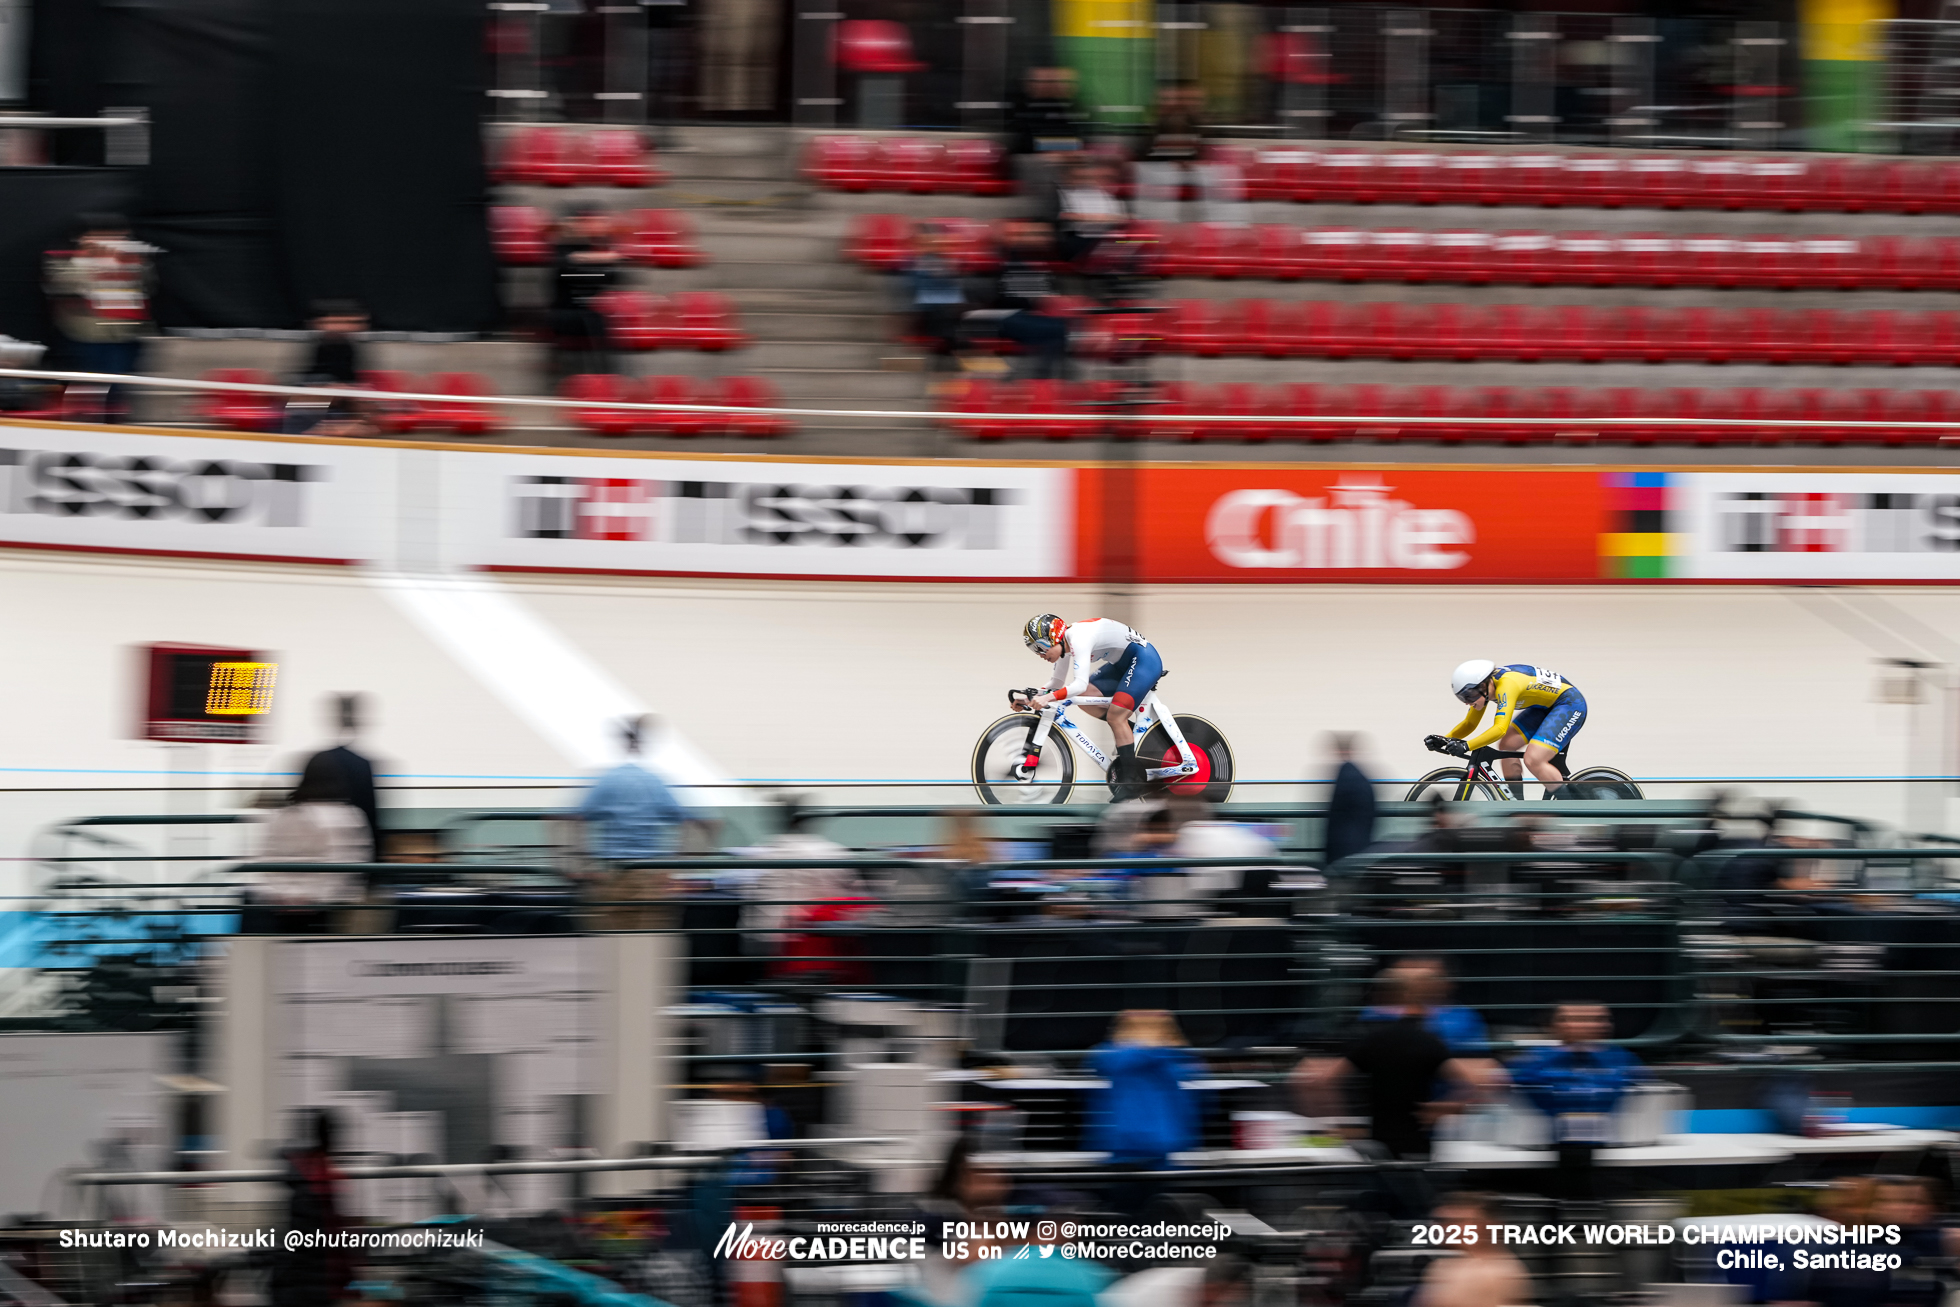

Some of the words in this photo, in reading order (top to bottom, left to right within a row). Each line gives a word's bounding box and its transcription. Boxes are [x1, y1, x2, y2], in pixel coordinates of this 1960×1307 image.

[1204, 488, 1487, 570] Chile
[1124, 656, 1137, 688] JAPAN
[1555, 710, 1582, 743] UKRAINE
